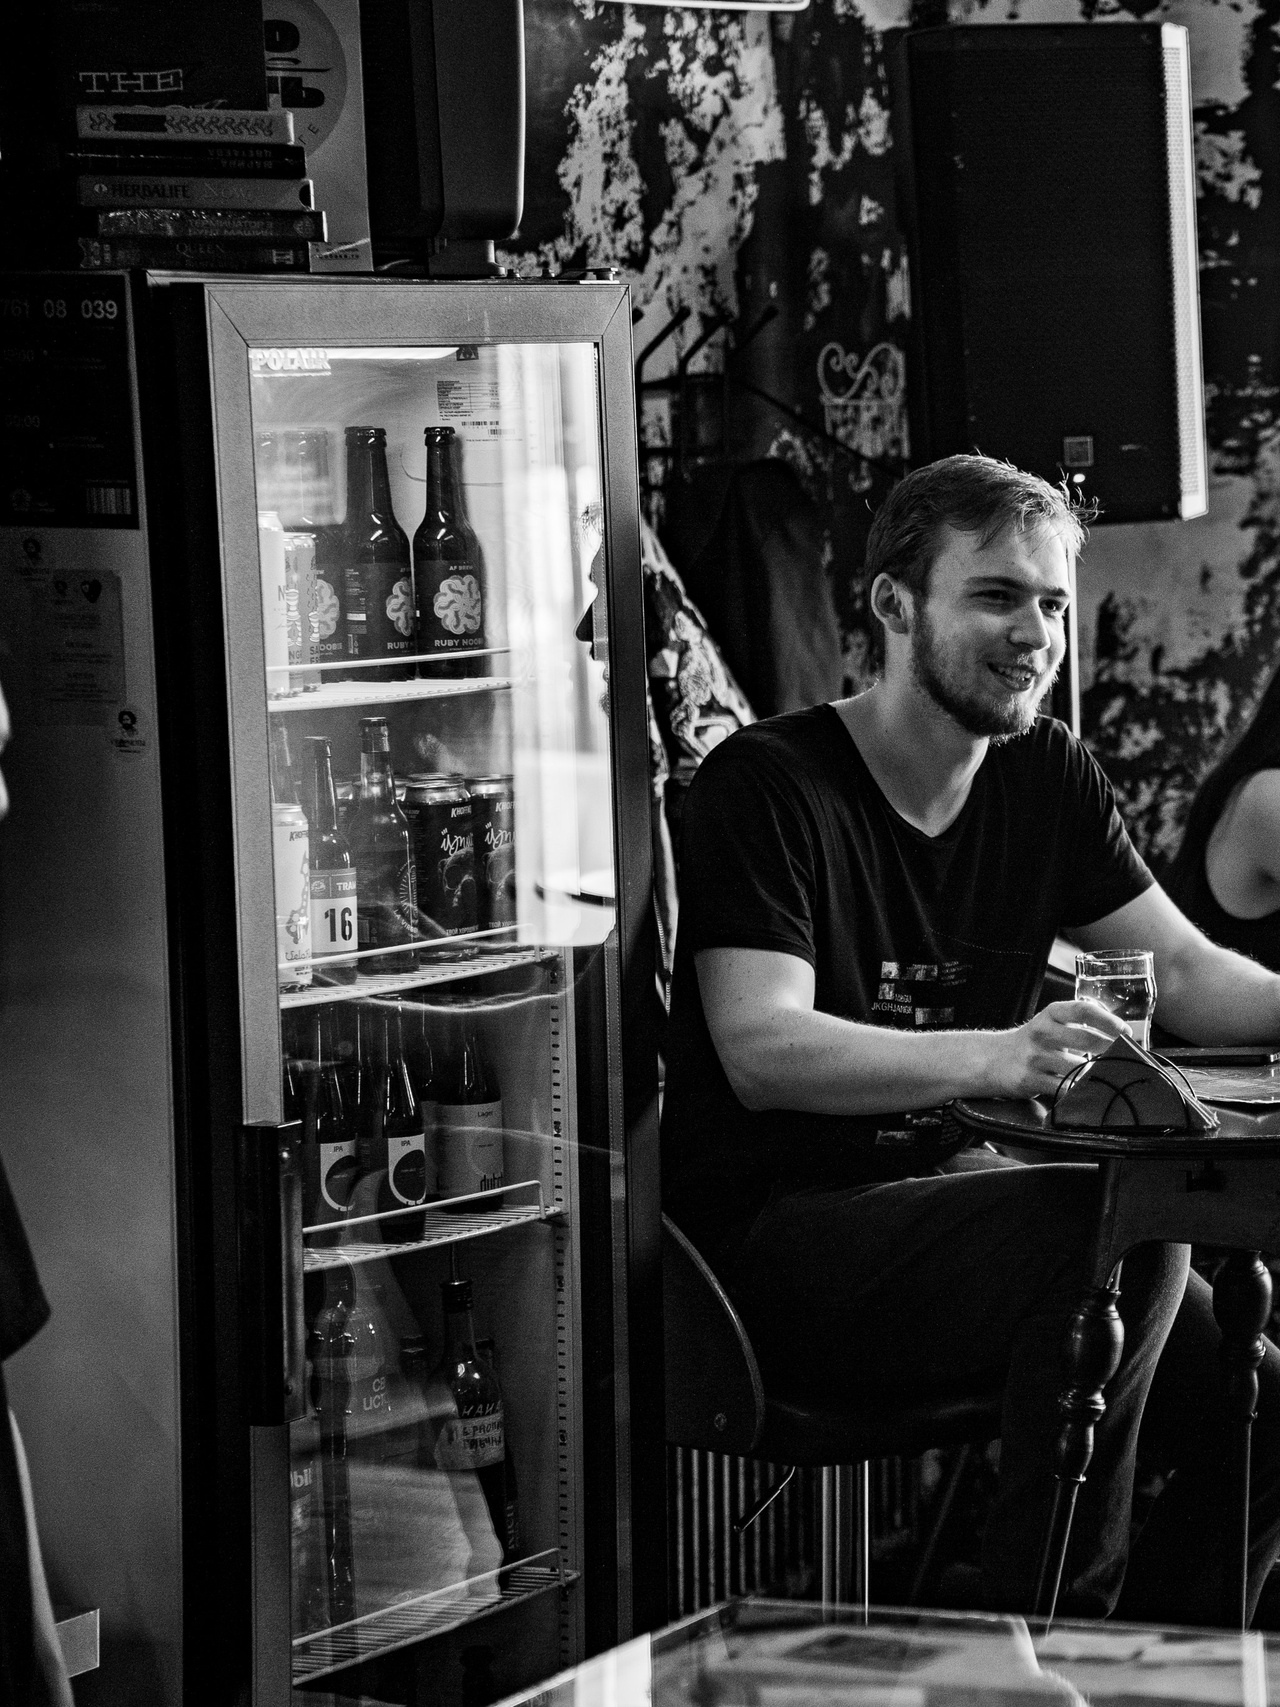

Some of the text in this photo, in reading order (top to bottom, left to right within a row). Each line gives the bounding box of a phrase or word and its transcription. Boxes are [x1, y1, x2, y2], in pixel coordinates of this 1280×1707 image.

[79, 69, 183, 93] THE
[111, 183, 191, 199] HERBALIFE
[42, 298, 69, 319] 08
[81, 299, 119, 321] 039
[387, 641, 410, 650] RUBY
[434, 639, 460, 647] RUBY
[324, 907, 353, 942] 16
[333, 1145, 344, 1153] IPA
[400, 1139, 411, 1148] IPA
